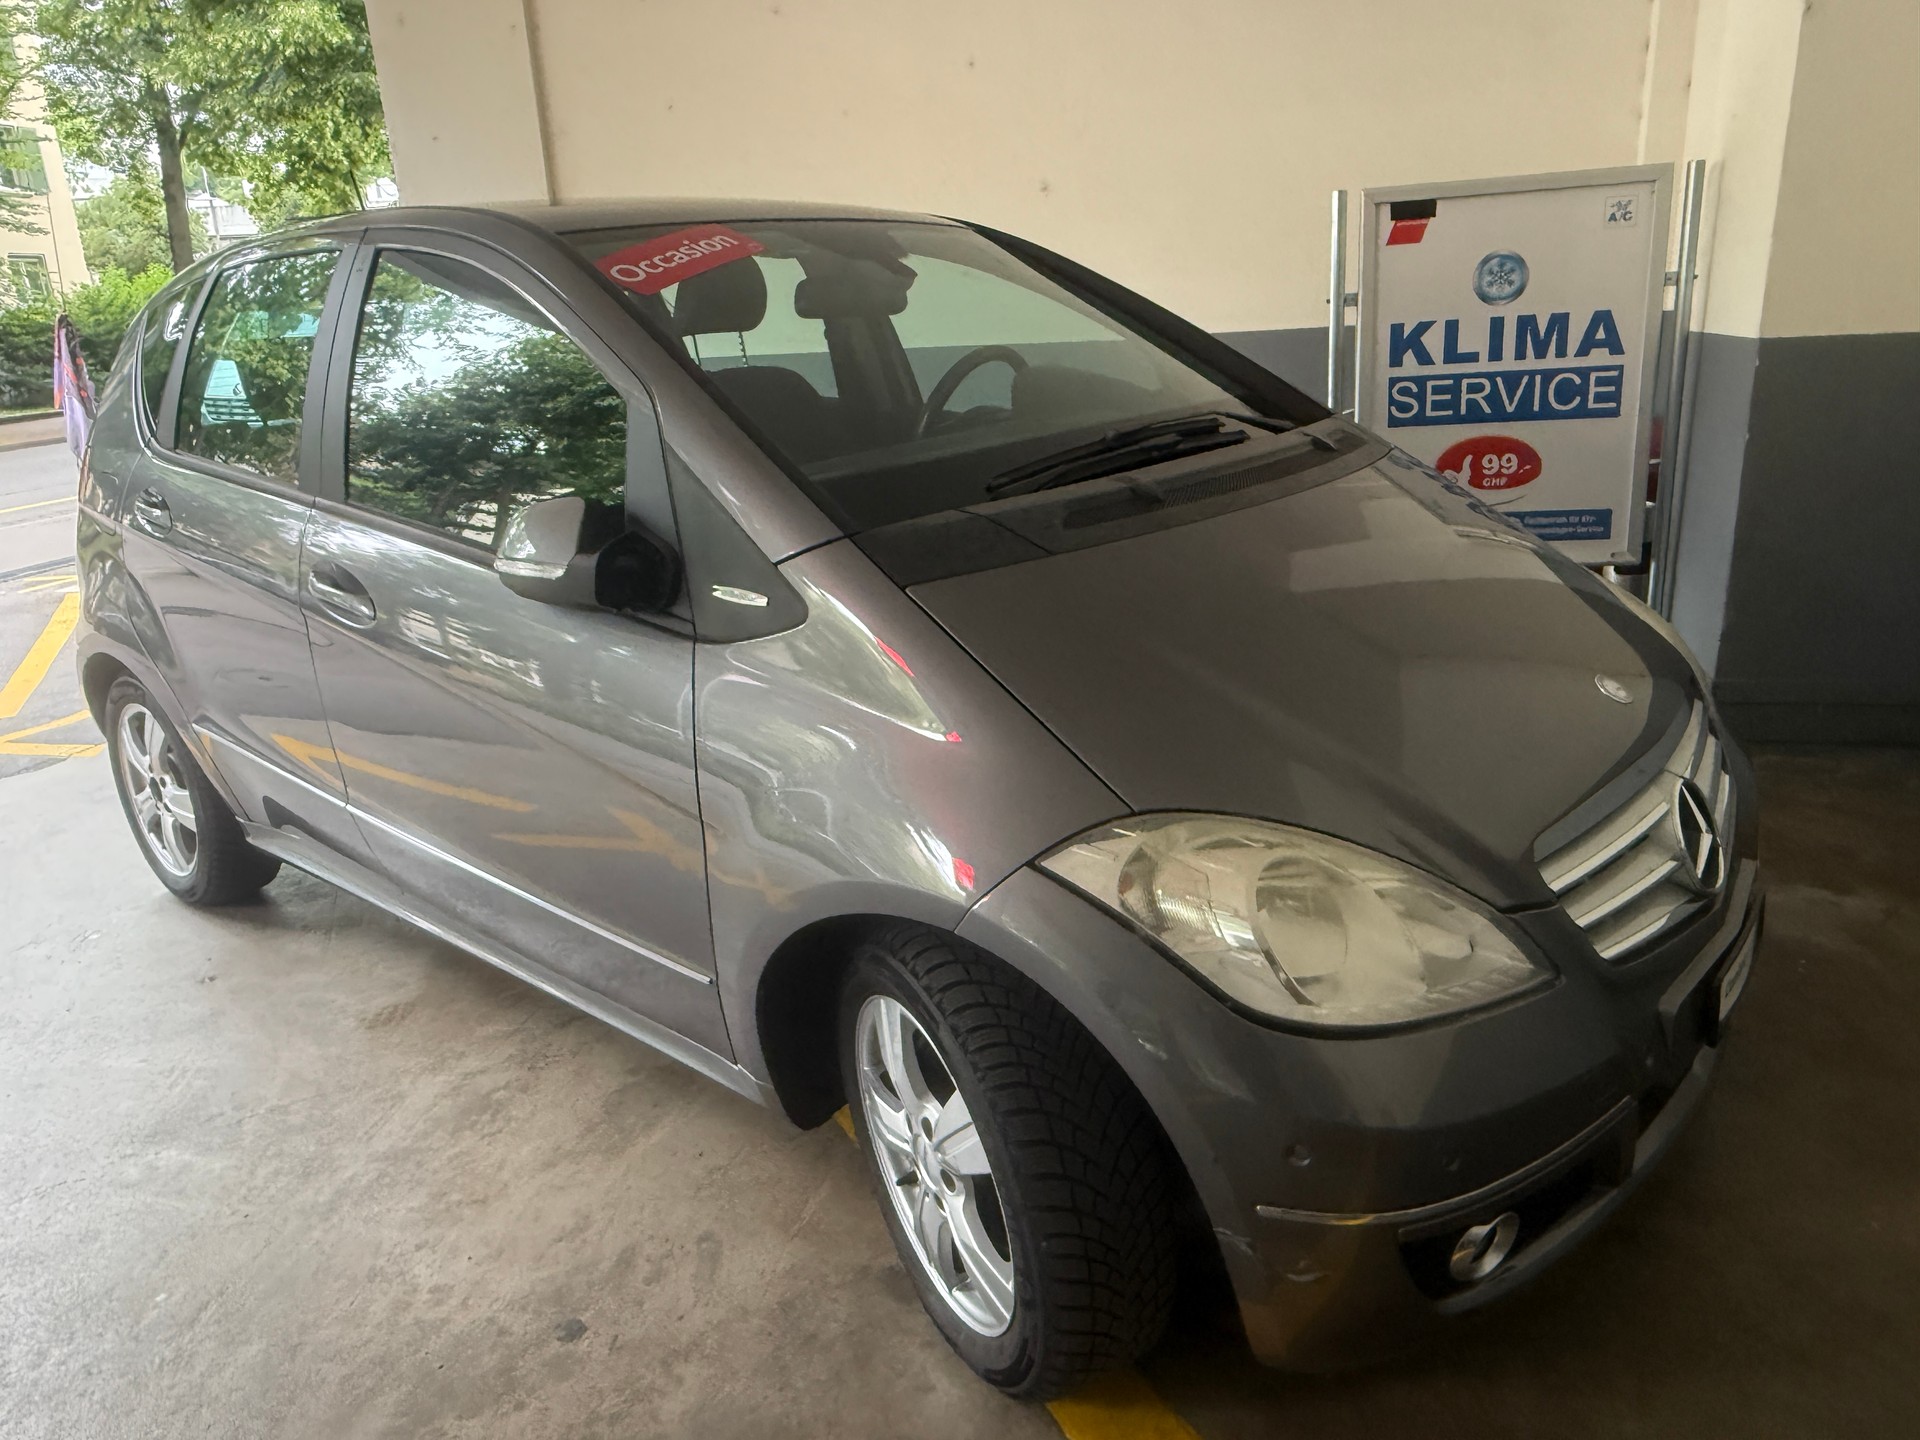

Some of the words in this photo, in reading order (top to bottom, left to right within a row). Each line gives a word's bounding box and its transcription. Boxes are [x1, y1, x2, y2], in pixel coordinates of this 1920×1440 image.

[610, 235, 739, 282] Occasion
[1389, 309, 1625, 367] KLIMA
[1390, 370, 1619, 418] SERVICE
